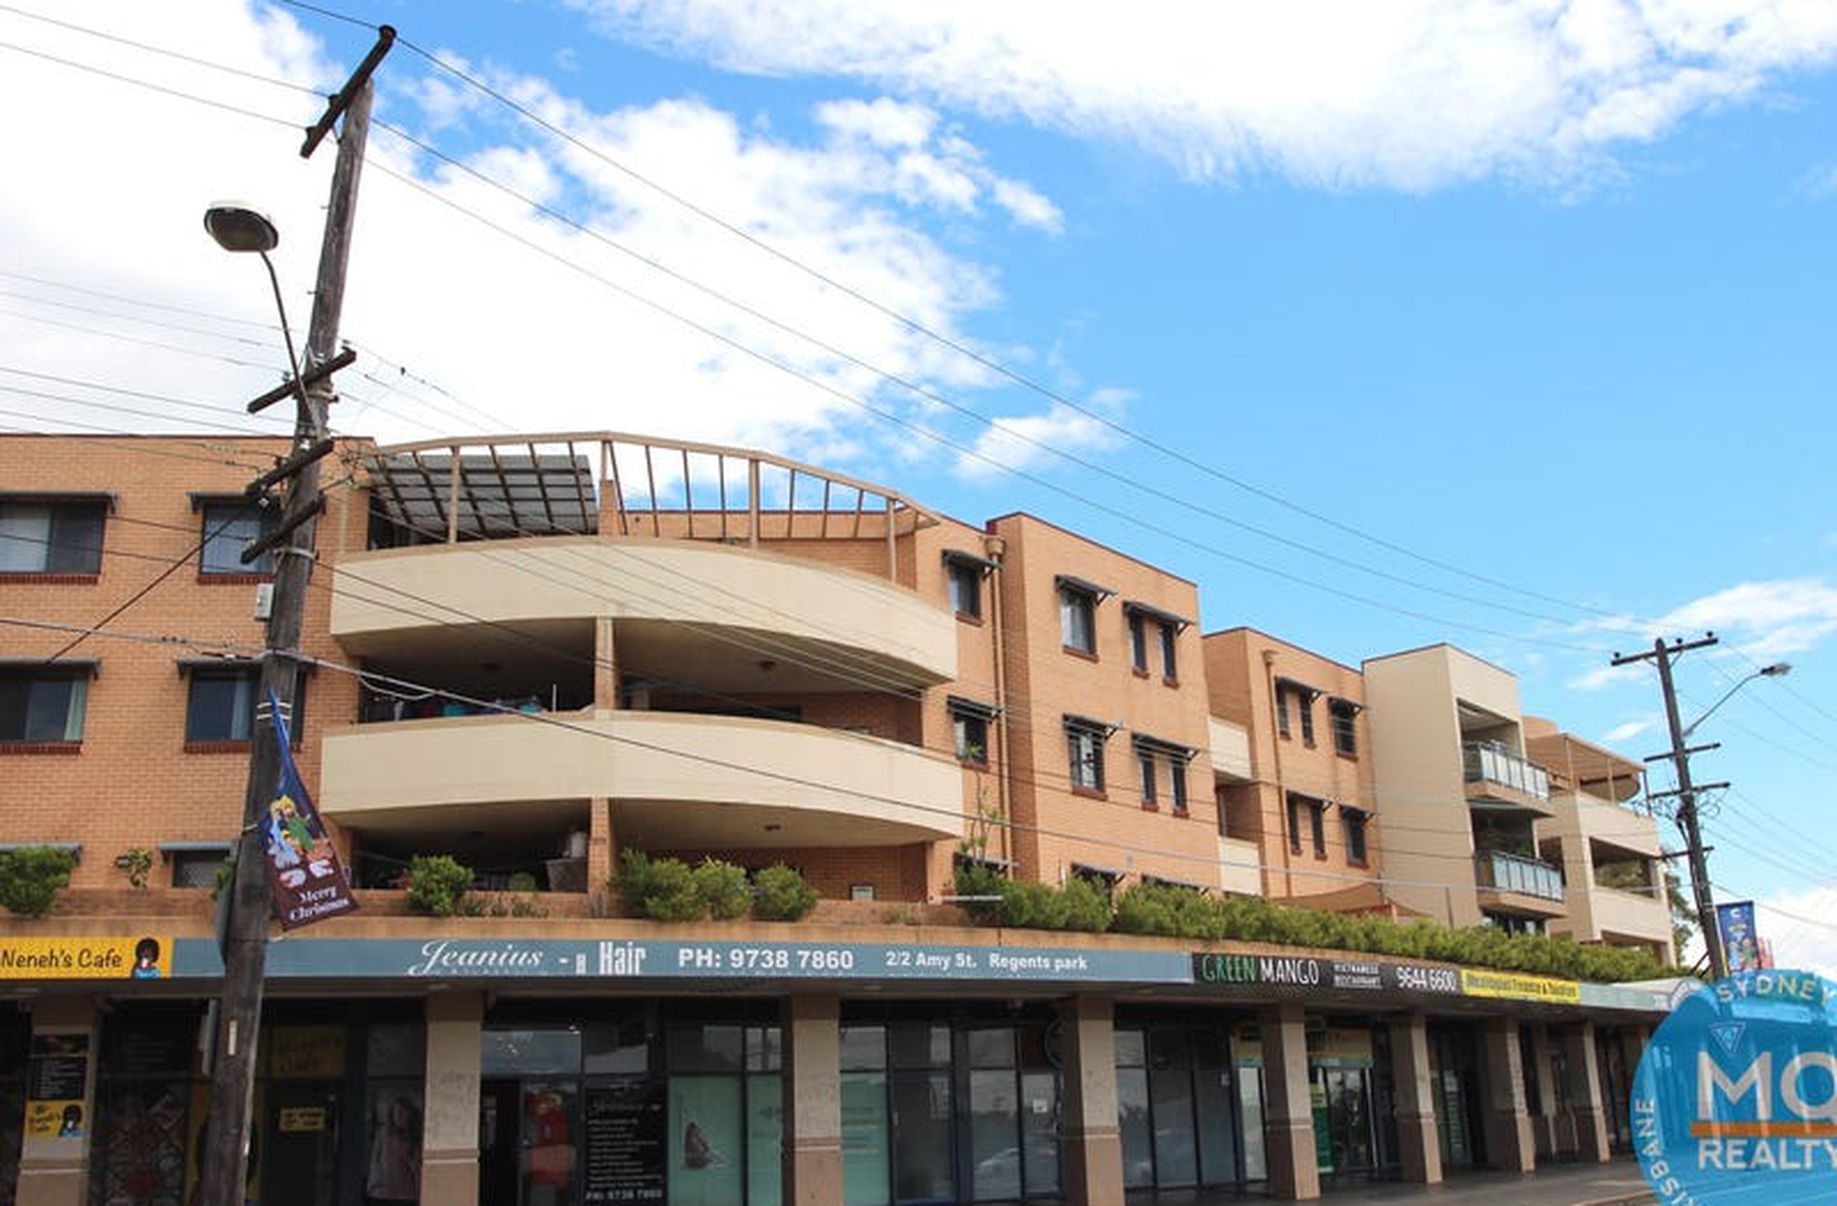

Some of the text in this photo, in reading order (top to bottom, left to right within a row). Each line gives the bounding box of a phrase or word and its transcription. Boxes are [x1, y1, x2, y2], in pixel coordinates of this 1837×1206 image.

[299, 886, 337, 903] Merry
[1, 948, 122, 968] Neneh's Cafe
[408, 940, 544, 976] Jeanius
[599, 941, 646, 975] Hair
[678, 947, 722, 968] PH:
[729, 948, 789, 969] 9738
[797, 949, 854, 970] 7860
[885, 951, 911, 967] 2/2
[916, 952, 950, 970] Amy
[955, 952, 977, 968] St.
[988, 953, 1050, 971] Regents
[1053, 955, 1088, 971] park
[1202, 955, 1319, 984] GREEN MANGO
